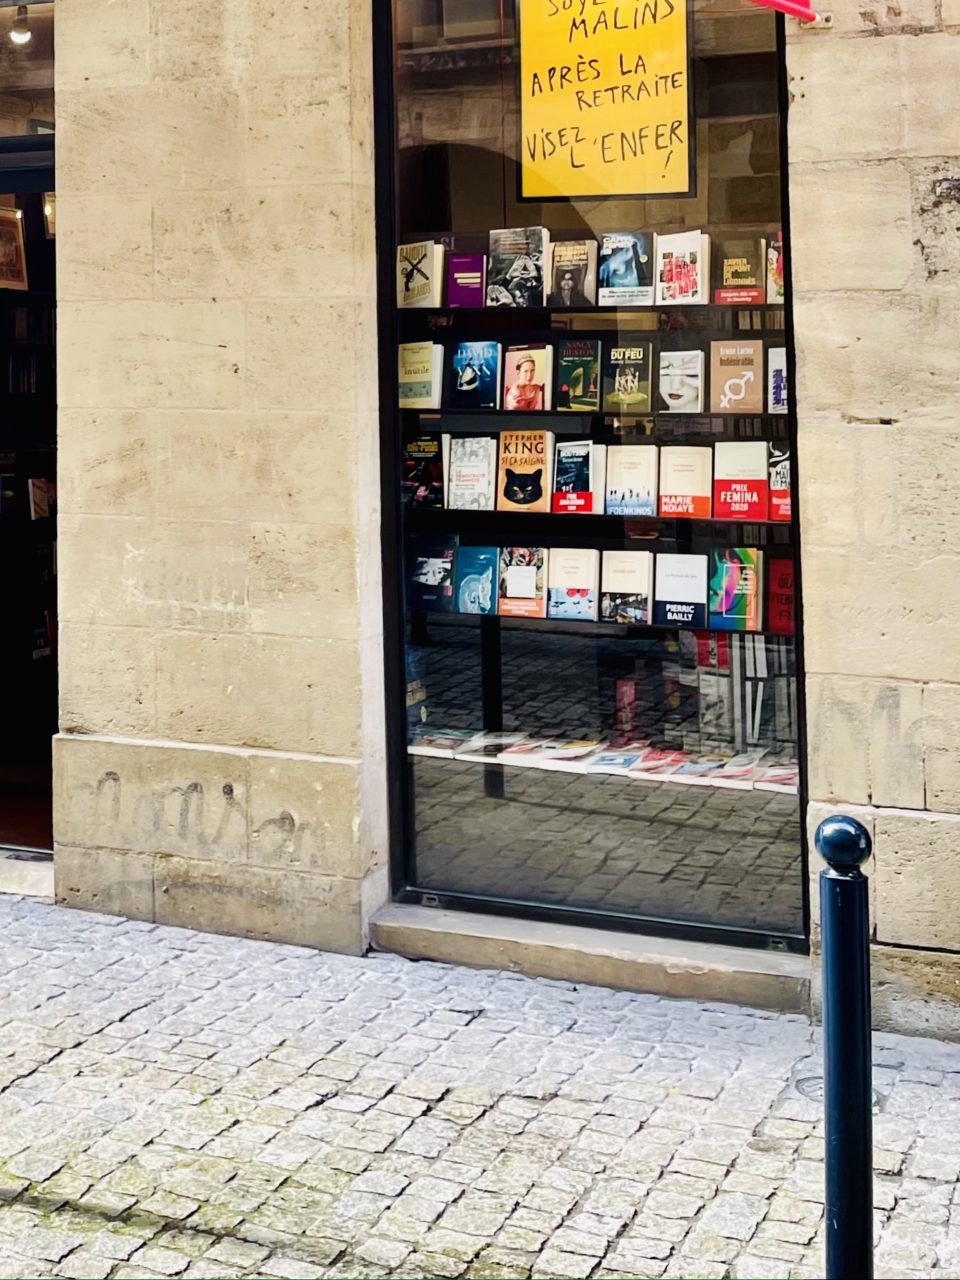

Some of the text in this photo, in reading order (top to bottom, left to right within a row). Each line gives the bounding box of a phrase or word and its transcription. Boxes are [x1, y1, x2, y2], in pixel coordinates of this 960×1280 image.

[531, 53, 647, 97] APRÈS LA
[610, 349, 644, 360] DU FEU
[503, 434, 544, 442] STEPHEN
[503, 442, 544, 455] KING
[731, 483, 748, 492] PRIX
[661, 495, 693, 505] MARIE
[720, 491, 759, 503] FEMINA
[661, 504, 695, 513] NDIAYE
[665, 603, 695, 613] PIERRIC
[666, 612, 693, 621] BAILLY
